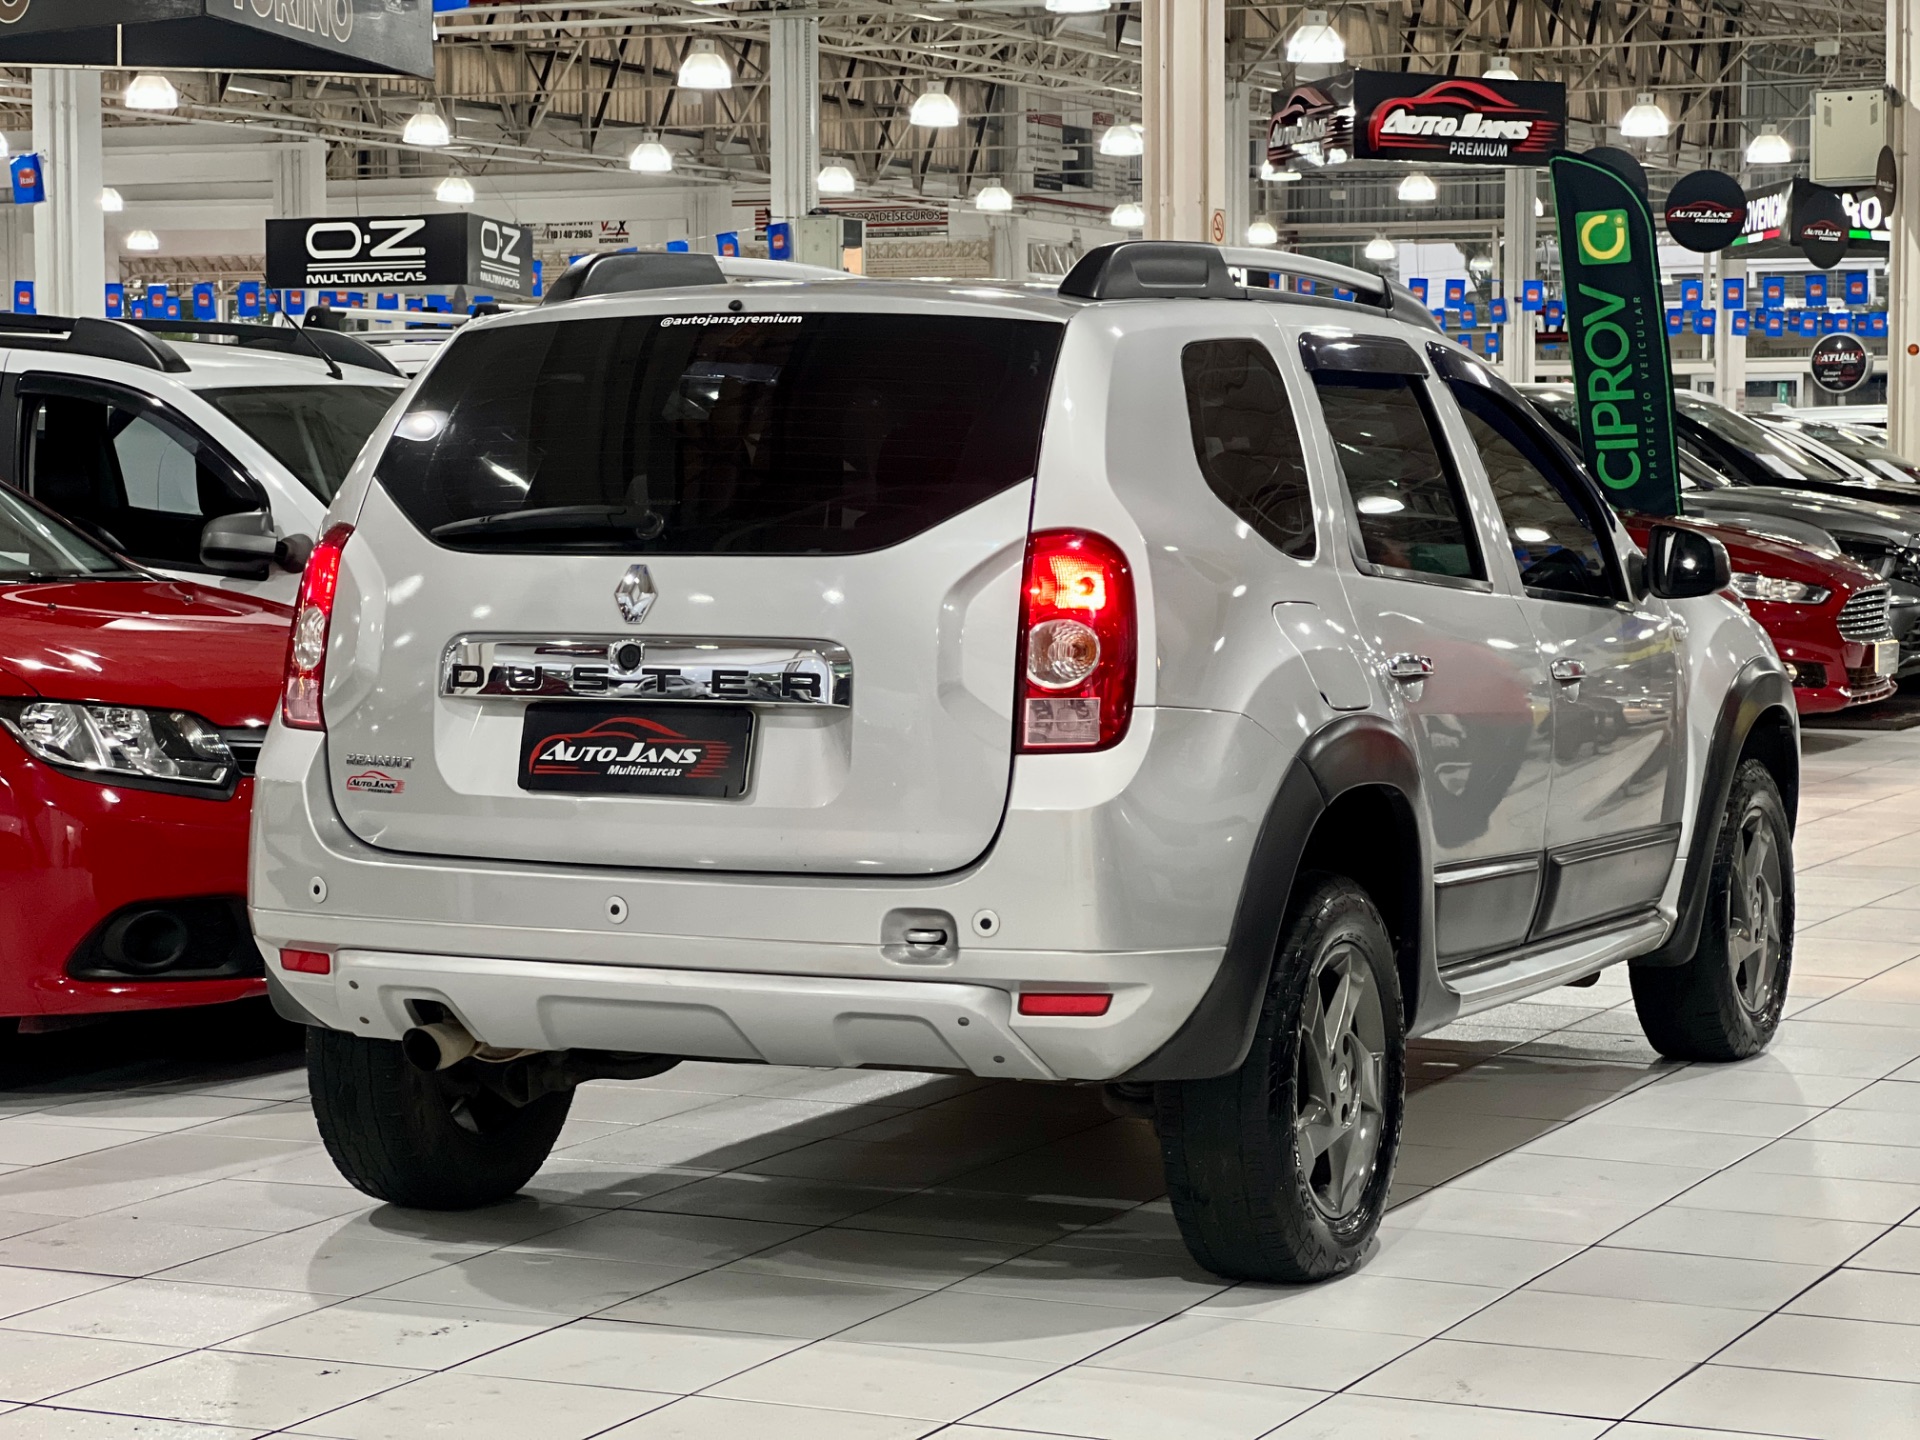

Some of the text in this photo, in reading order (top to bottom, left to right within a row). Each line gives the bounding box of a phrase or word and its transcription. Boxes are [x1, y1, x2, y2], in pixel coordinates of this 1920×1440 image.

[1449, 142, 1508, 157] PREMIUM
[894, 210, 941, 221] SEGUROS
[306, 271, 427, 284] MULTIMARCAS
[480, 271, 520, 289] MULTIMARCAS
[660, 314, 803, 328] @autojanspremium
[1578, 283, 1642, 490] CIPROV
[1633, 296, 1658, 480] PROTEÇÃO VEICULAR
[451, 664, 822, 698] DUSTER
[607, 765, 682, 777] Multimarcas
